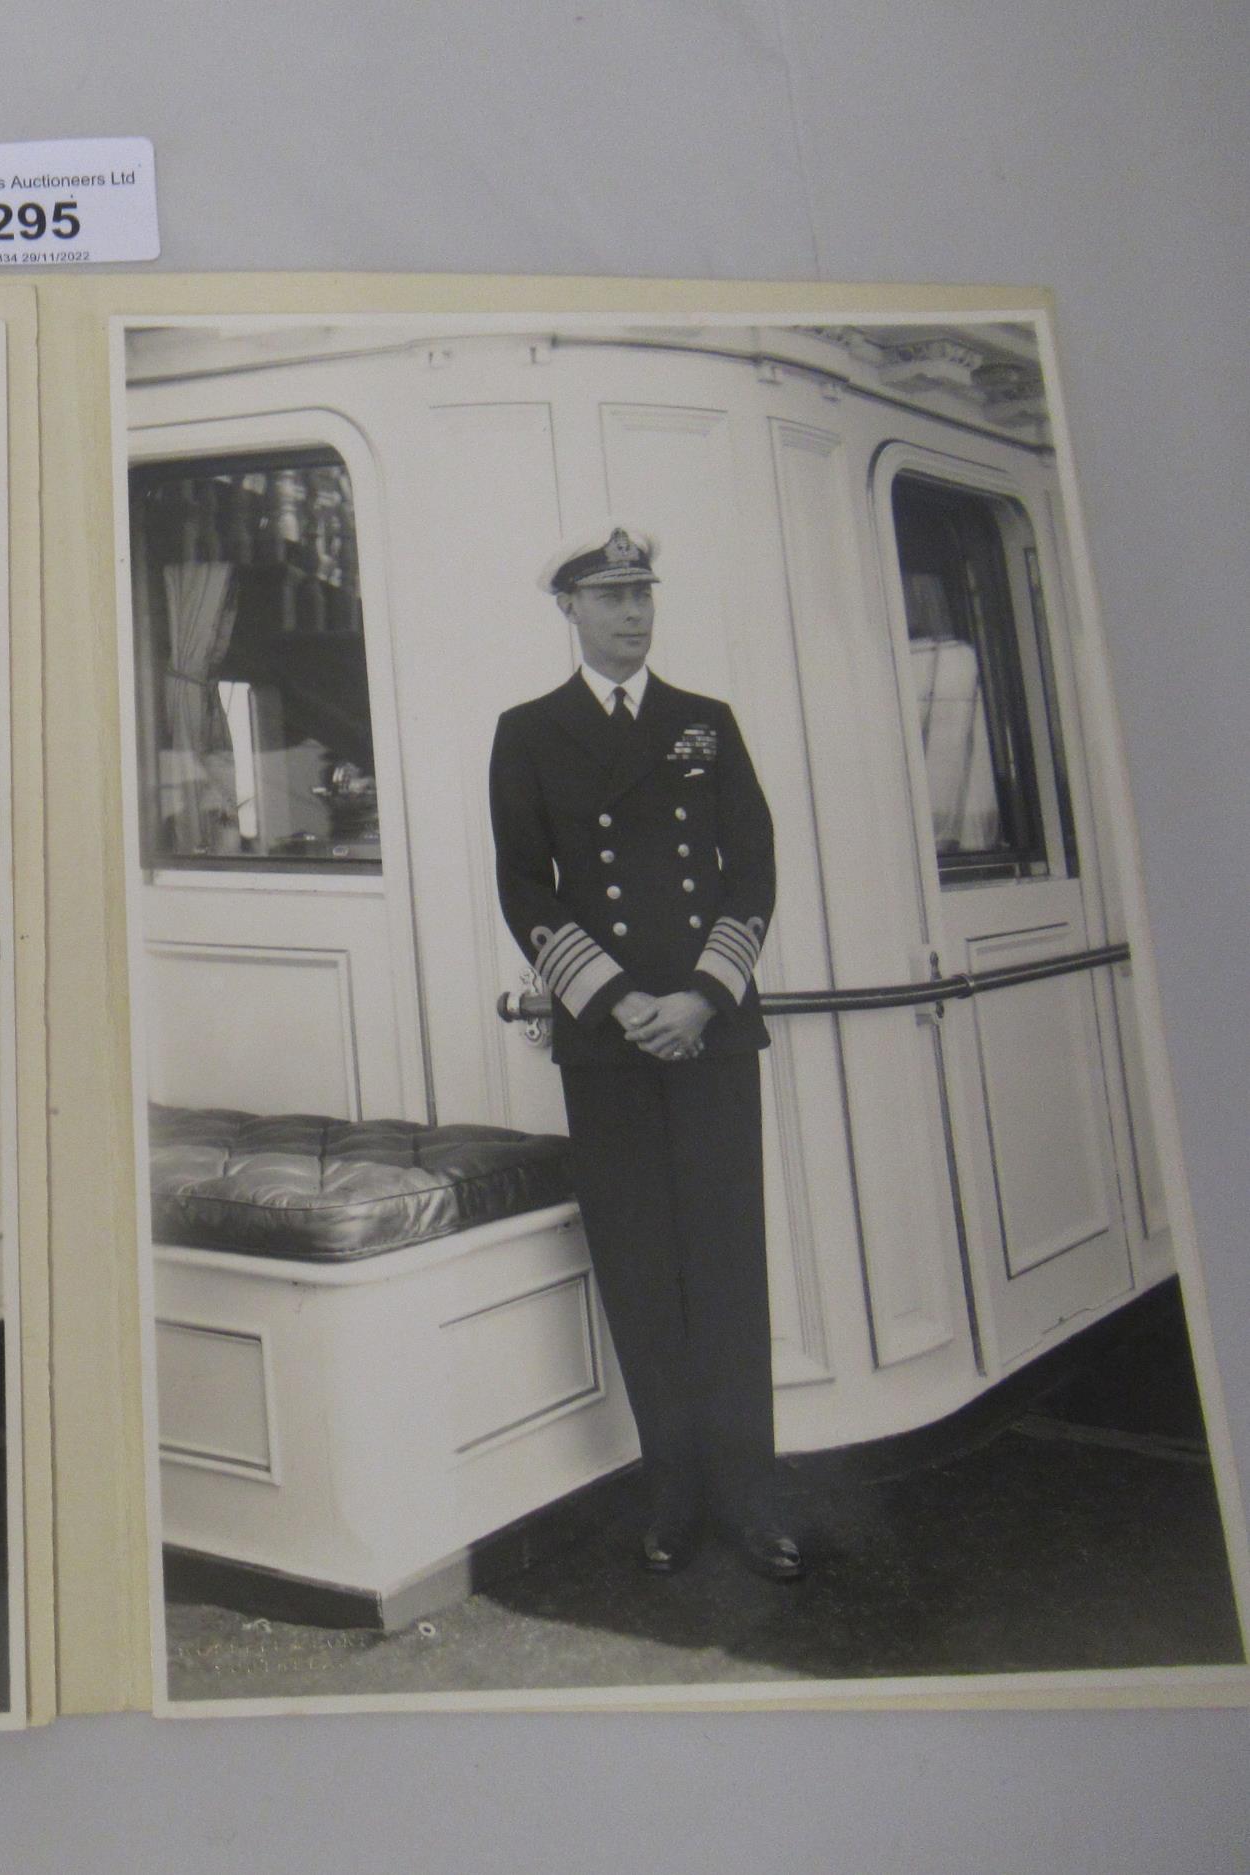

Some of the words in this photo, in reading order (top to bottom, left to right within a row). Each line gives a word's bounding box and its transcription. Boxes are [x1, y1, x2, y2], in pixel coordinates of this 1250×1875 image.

[10, 174, 106, 189] Auctioneers
[110, 171, 136, 186] Ltd
[22, 251, 90, 263] 29/11/2022
